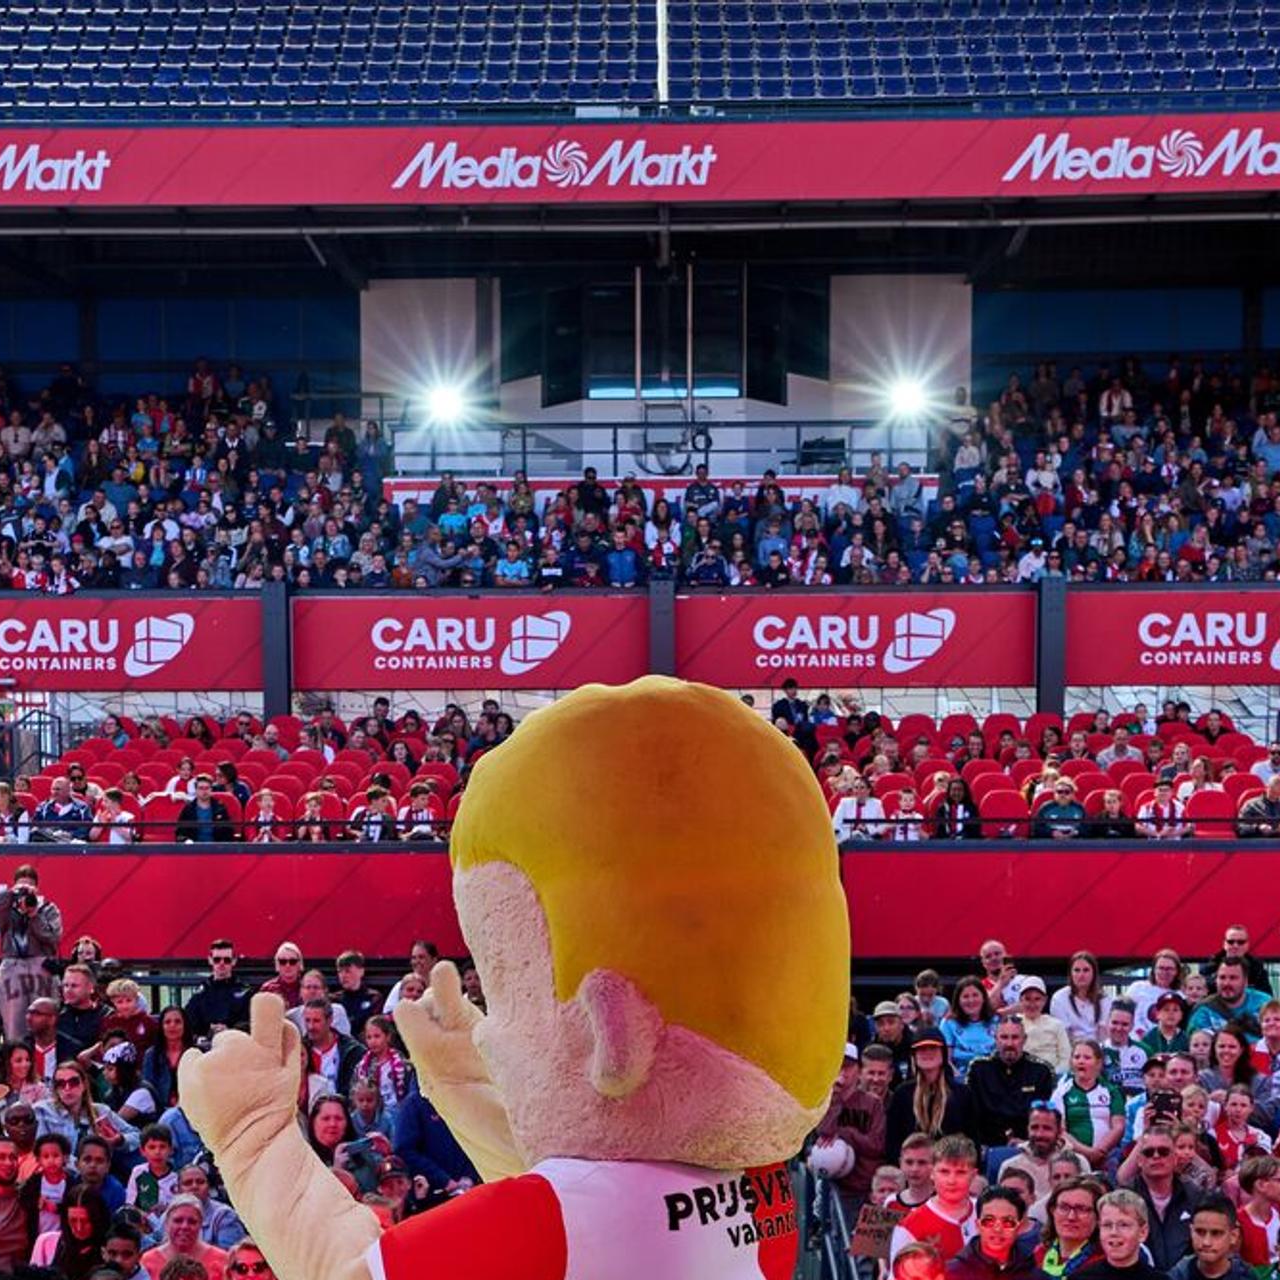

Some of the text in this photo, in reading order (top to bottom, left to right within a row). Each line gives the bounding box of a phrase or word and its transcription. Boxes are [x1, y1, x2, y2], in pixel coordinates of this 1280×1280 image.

[371, 617, 495, 652] CARU
[753, 615, 879, 650] CARU
[1138, 612, 1266, 647] CARU
[374, 655, 494, 669] CONTAINERS
[756, 654, 876, 667] CONTAINERS
[1140, 651, 1263, 665] CONTAINERS
